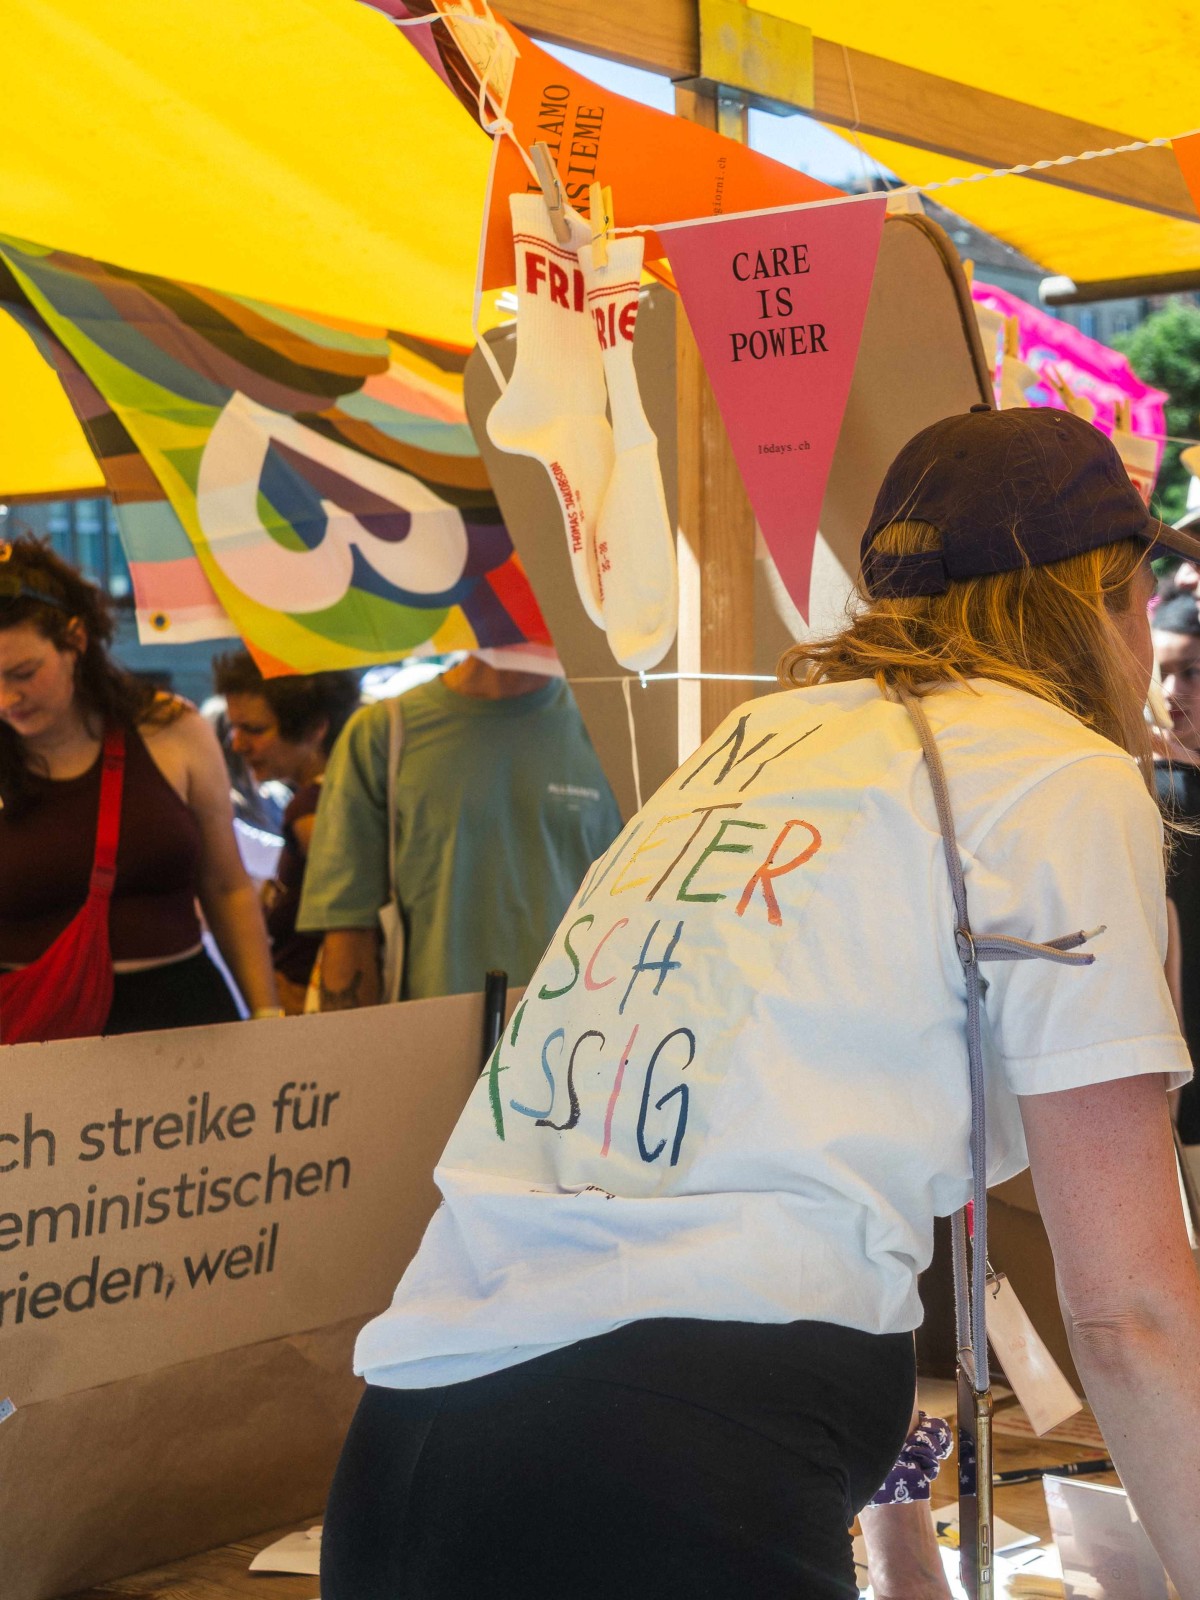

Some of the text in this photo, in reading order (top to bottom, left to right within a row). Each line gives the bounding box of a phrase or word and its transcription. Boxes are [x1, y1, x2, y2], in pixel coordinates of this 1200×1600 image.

[732, 243, 811, 282] CARE
[592, 301, 639, 351] RIE
[756, 287, 793, 320] IS
[729, 323, 829, 362] POWER
[758, 441, 811, 455] 16days.ch
[567, 511, 583, 554] THOMAS
[538, 914, 684, 1016] SCH
[0, 1081, 341, 1173] ch streike für
[0, 1153, 351, 1251] eministischen
[183, 1222, 280, 1289] weil
